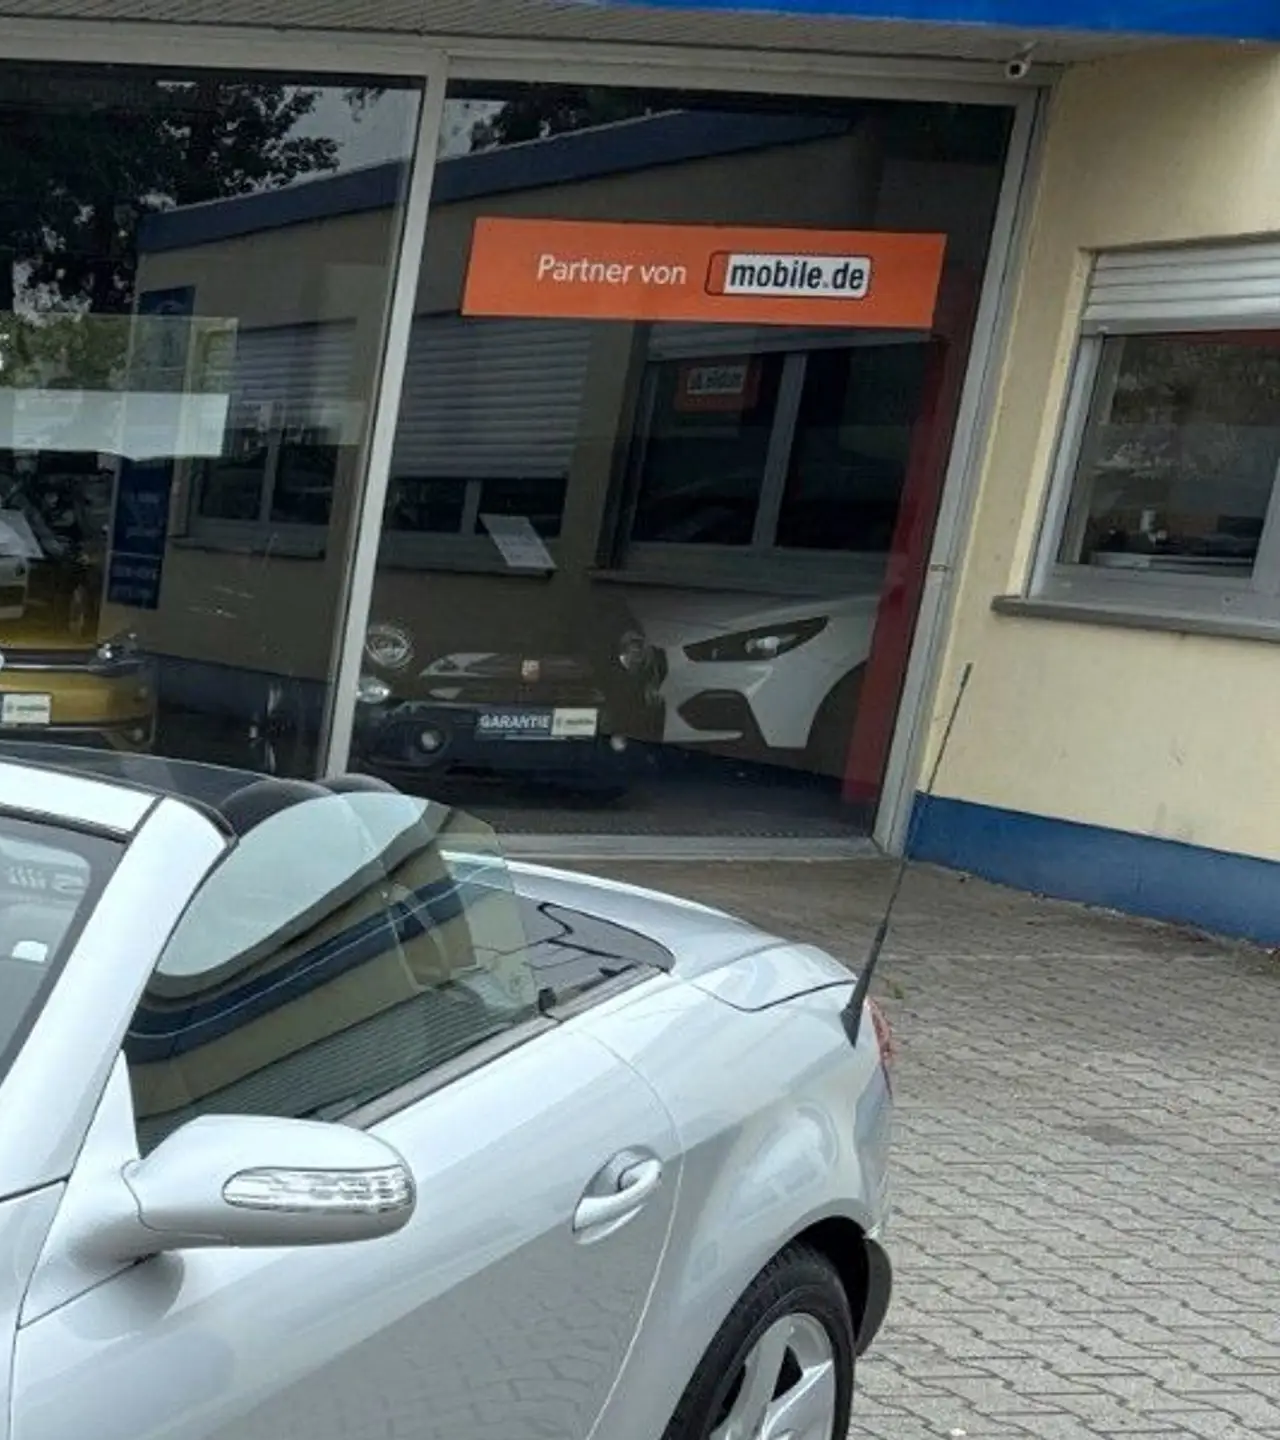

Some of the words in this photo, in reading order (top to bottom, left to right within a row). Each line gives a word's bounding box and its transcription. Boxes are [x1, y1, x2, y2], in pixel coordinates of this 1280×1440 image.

[537, 254, 634, 285] Partner
[640, 263, 687, 286] von
[729, 258, 864, 291] mobile.de
[479, 714, 551, 729] GARANTIE
